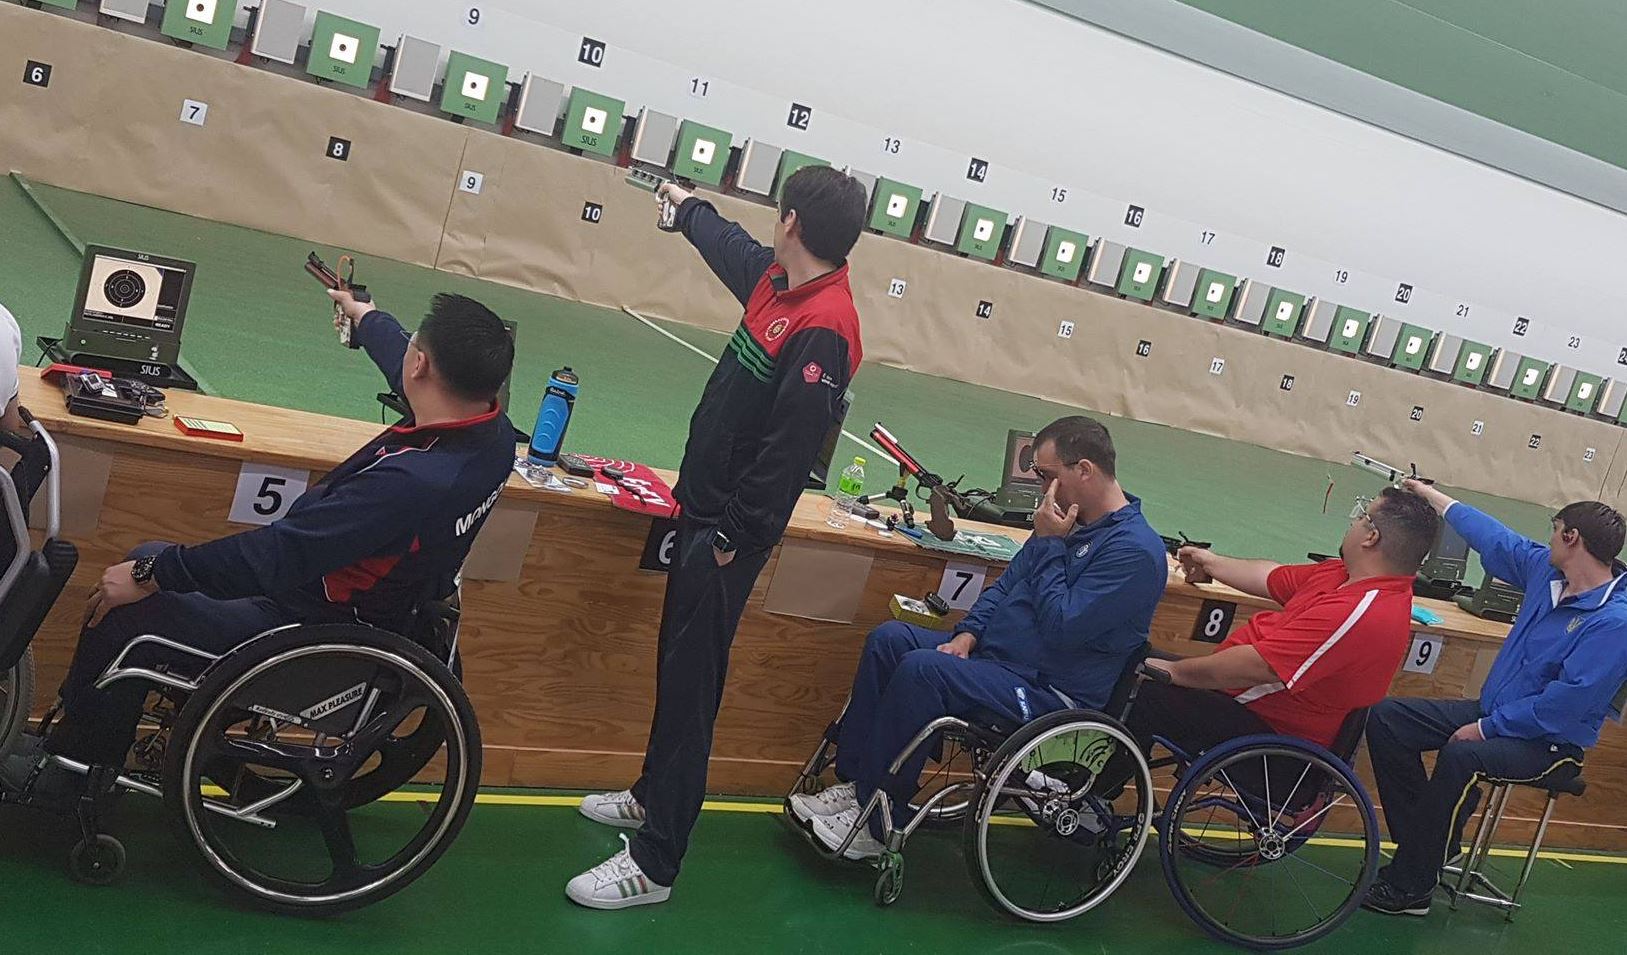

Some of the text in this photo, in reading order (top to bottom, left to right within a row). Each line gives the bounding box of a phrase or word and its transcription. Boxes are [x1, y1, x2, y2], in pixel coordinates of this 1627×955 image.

[468, 8, 480, 25] 9
[583, 44, 603, 63] 10
[31, 67, 44, 82] 6
[692, 78, 709, 96] 11
[189, 105, 200, 120] 7
[792, 109, 809, 127] 12
[581, 135, 597, 147] SIUS
[885, 138, 900, 154] 13
[333, 142, 344, 157] 8
[971, 163, 986, 179] 14
[466, 176, 476, 189] 9
[1052, 187, 1067, 203] 15
[585, 206, 601, 221] 10
[1128, 209, 1142, 225] 16
[1201, 231, 1215, 245] 17
[1270, 251, 1283, 265] 18
[1336, 270, 1348, 283] 19
[891, 283, 904, 295] 13
[1397, 286, 1411, 301] 20
[978, 303, 991, 317] 14
[1456, 304, 1469, 317] 21
[1060, 323, 1072, 336] 15
[1514, 320, 1527, 333] 22
[1139, 342, 1150, 354] 16
[1568, 336, 1580, 349] 23
[140, 364, 161, 376] SIUS
[1212, 361, 1223, 372] 17
[1282, 377, 1293, 389] 18
[1349, 394, 1359, 404] 19
[1411, 407, 1423, 419] 20
[1472, 422, 1482, 433] 21
[1529, 435, 1541, 446] 22
[1584, 449, 1595, 460] 23
[253, 477, 286, 515] 5
[951, 571, 974, 601] 7
[1204, 608, 1224, 636] 8
[1415, 637, 1432, 666] 9
[310, 702, 328, 719] MAX
[329, 687, 362, 710] PLEASURE
